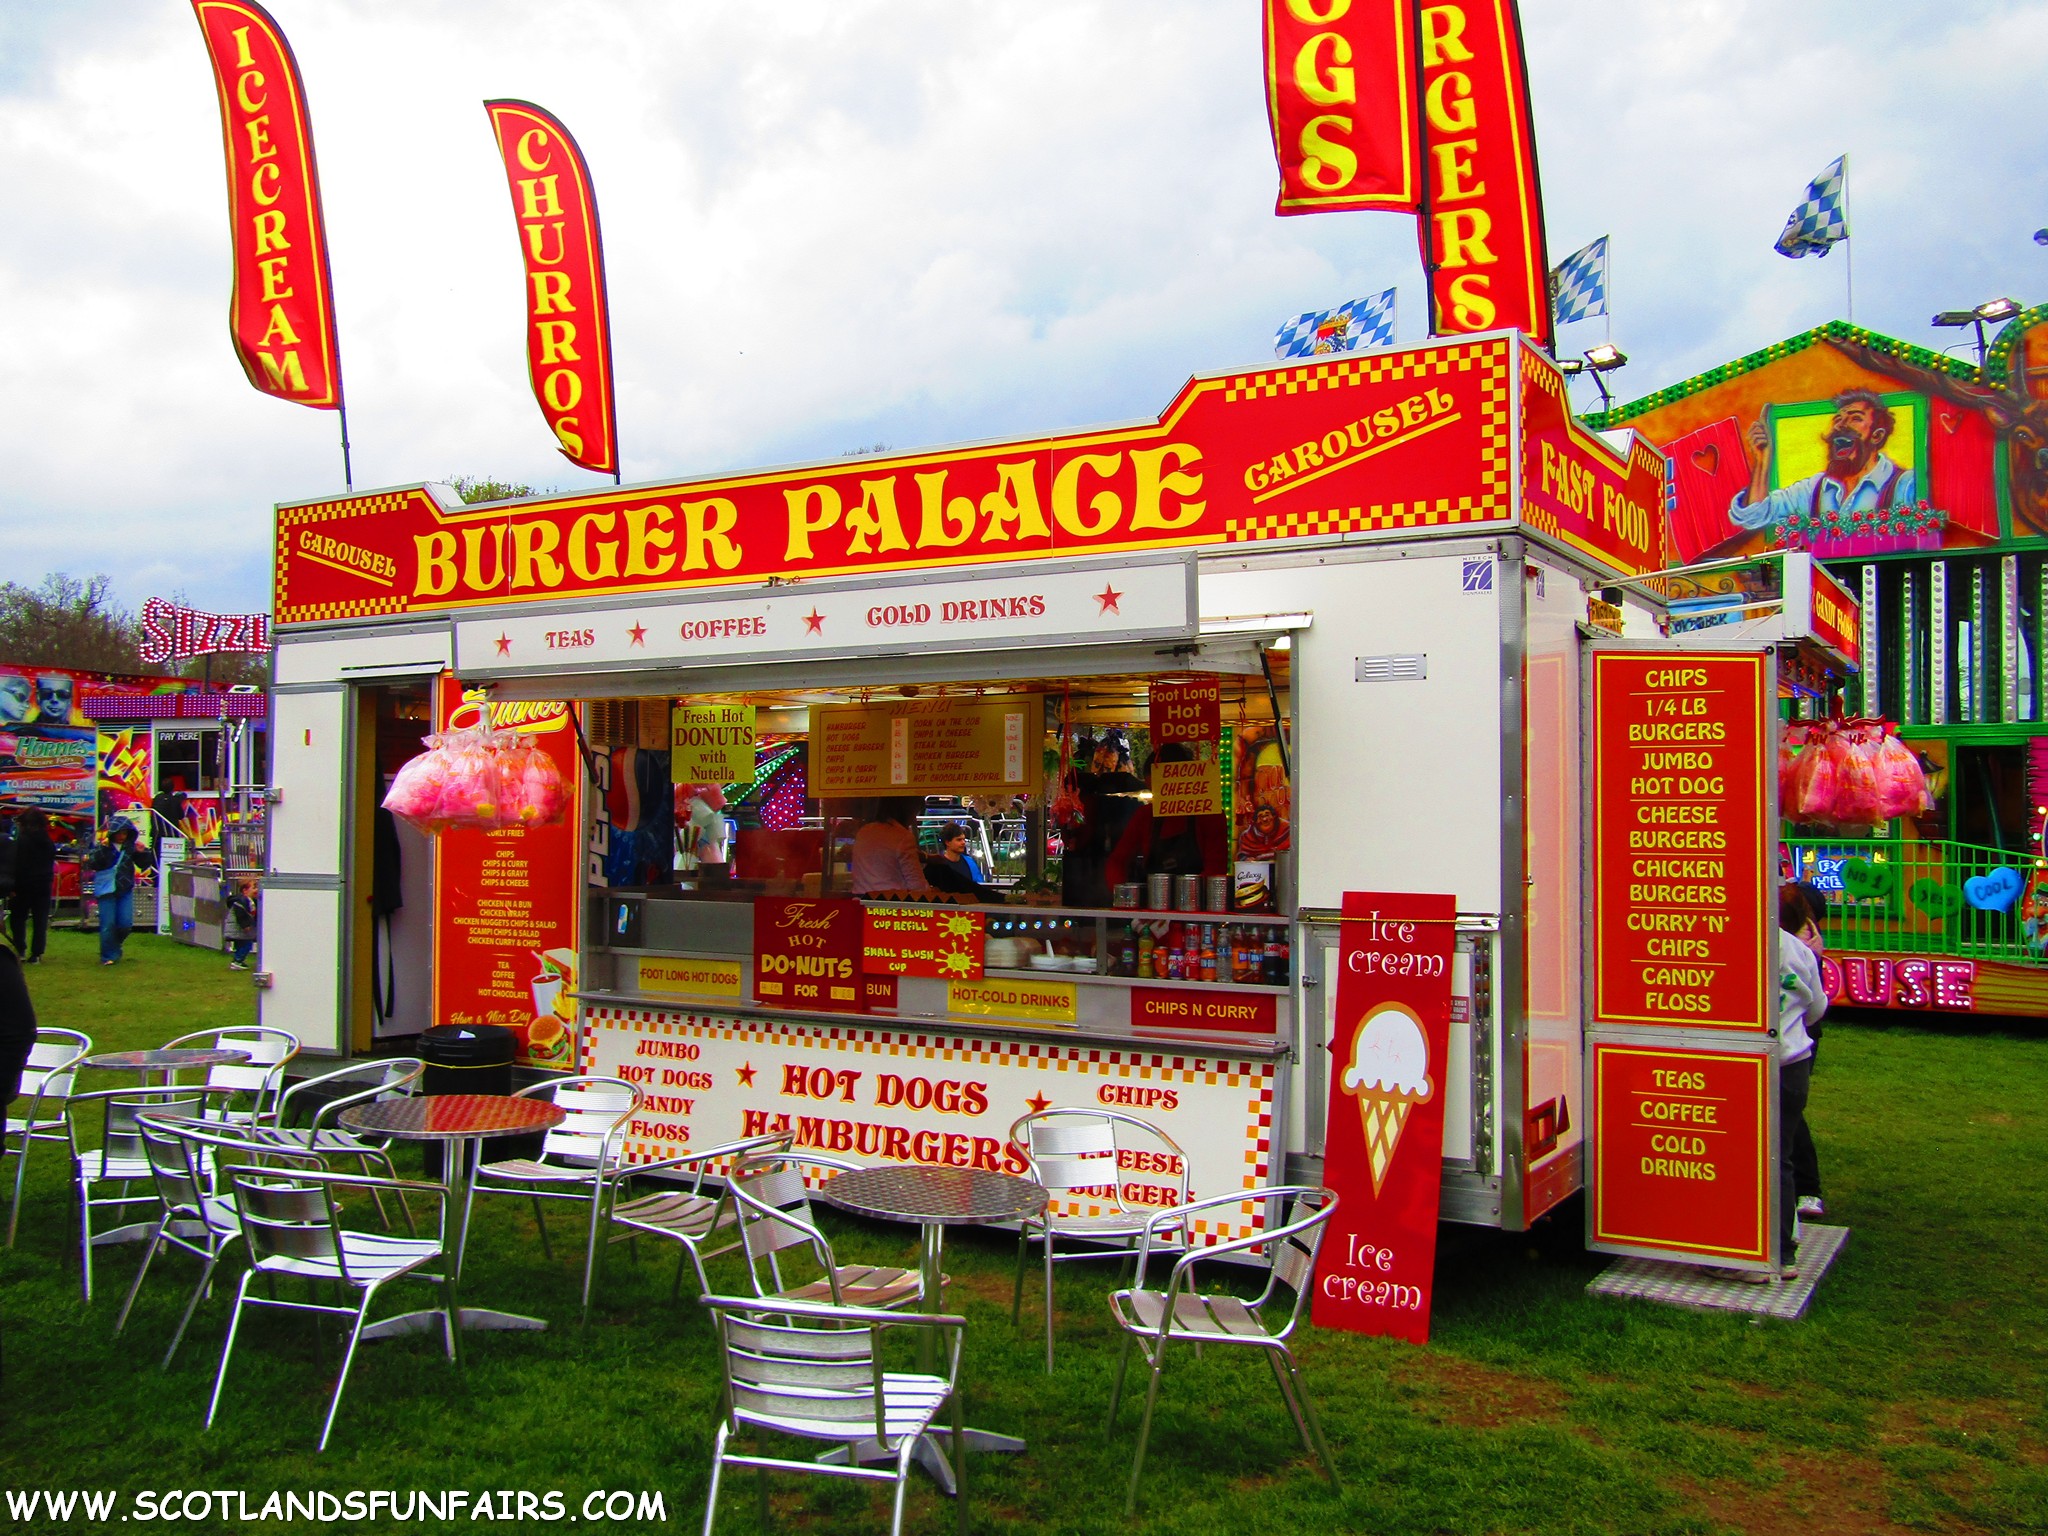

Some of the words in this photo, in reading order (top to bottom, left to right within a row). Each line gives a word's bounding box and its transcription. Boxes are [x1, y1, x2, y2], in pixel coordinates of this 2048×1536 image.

[1421, 4, 1498, 331] RGERS
[516, 129, 584, 459] CHURROS
[1244, 387, 1455, 491] CAROUSEL
[1540, 439, 1595, 522] FAST
[1602, 482, 1650, 554] FOOD
[412, 497, 743, 598] BURGER
[783, 443, 1206, 562] PALACE
[298, 530, 397, 577] CAROUSEL
[545, 628, 595, 650] TEAS
[680, 616, 767, 641] COFFEE
[866, 603, 931, 628] COLD
[941, 594, 1046, 623] DRINKS
[1815, 591, 1836, 629] CANDY
[1837, 608, 1853, 643] FLOSS
[1645, 668, 1707, 688] CHIPS
[1151, 689, 1180, 702] Foot
[1183, 686, 1217, 701] Long
[683, 709, 716, 723] Fresh
[721, 709, 744, 723] Hot
[888, 700, 952, 715] MENU
[1167, 704, 1201, 719] Hot
[1645, 699, 1677, 717] 1/4
[1682, 697, 1707, 716] LB
[160, 732, 176, 741] PAY
[177, 732, 198, 741] HERE
[674, 726, 753, 746] DONUTS
[1161, 721, 1210, 738] Dogs
[1628, 721, 1726, 742] BURGERS
[700, 750, 727, 763] with
[1641, 751, 1713, 770] JUMBO
[690, 766, 735, 780] Nutella
[1162, 763, 1206, 779] BACON
[22, 780, 45, 789] HIRE
[50, 781, 71, 790] THIS
[1160, 780, 1210, 797] CHEESE
[1631, 776, 1675, 795] HOT
[1679, 776, 1725, 795] DOG
[1159, 798, 1213, 815] BURGER
[1637, 805, 1718, 824] CHEESE
[507, 829, 525, 837] FRIES
[1629, 829, 1726, 849] BURGERS
[496, 850, 515, 858] CHIPS
[482, 869, 500, 877] CHIPS
[507, 860, 528, 868] CURRY
[1632, 859, 1724, 878] CHICKEN
[505, 879, 529, 887] CHEESE
[1237, 871, 1263, 881] Galaxy
[1629, 883, 1726, 904] BURGERS
[1974, 878, 2012, 901] COOL
[477, 899, 505, 907] CHICKEN
[480, 909, 506, 917] CHICKEN
[775, 903, 839, 930] Fresh
[1627, 912, 1694, 932] CURRY
[453, 917, 480, 925] CHICKEN
[480, 918, 509, 927] NUGGETS
[535, 921, 557, 929] SALAD
[873, 920, 891, 929] CUP
[1368, 910, 1416, 944] Ice
[788, 934, 827, 949] HOT
[1647, 937, 1709, 958] CHIPS
[864, 947, 897, 957] SMALL
[901, 949, 934, 960] SLUSH
[497, 961, 510, 969] TEA
[761, 953, 853, 979] DO'NUTS
[889, 963, 907, 972] CUP
[1348, 949, 1445, 978] cream
[492, 971, 516, 979] COFFEE
[492, 980, 515, 988] BOVRIL
[666, 969, 690, 981] LONG
[691, 971, 710, 983] HOT
[1642, 966, 1715, 986] CANDY
[492, 989, 529, 999] CHOCOLATE
[794, 984, 818, 998] FOR
[866, 983, 891, 996] BUN
[953, 988, 1017, 1004] HOT-COLD
[1020, 992, 1070, 1008] DRINKS
[1145, 1001, 1188, 1016] CHIPS
[1192, 1003, 1202, 1017] N
[1206, 1004, 1258, 1020] CURRY
[1645, 991, 1711, 1012] FLOSS
[486, 1010, 507, 1023] Nice
[509, 1009, 532, 1027] Day
[635, 1039, 700, 1062] JUMBO
[617, 1064, 656, 1084] HOT
[661, 1068, 713, 1092] DOGS
[1652, 1069, 1706, 1090] TEAS
[780, 1063, 863, 1103] HOT
[876, 1072, 989, 1118] DOGS
[1097, 1083, 1179, 1111] CHIPS
[1640, 1101, 1717, 1124] COFFEE
[629, 1120, 690, 1143] FLOSS
[741, 1108, 1030, 1177] HAMBURGERS
[1651, 1134, 1706, 1155] COLD
[1078, 1149, 1183, 1175] EESE
[1640, 1156, 1716, 1181] DRINKS
[1345, 1233, 1394, 1272] Ice
[1322, 1272, 1422, 1312] cream
